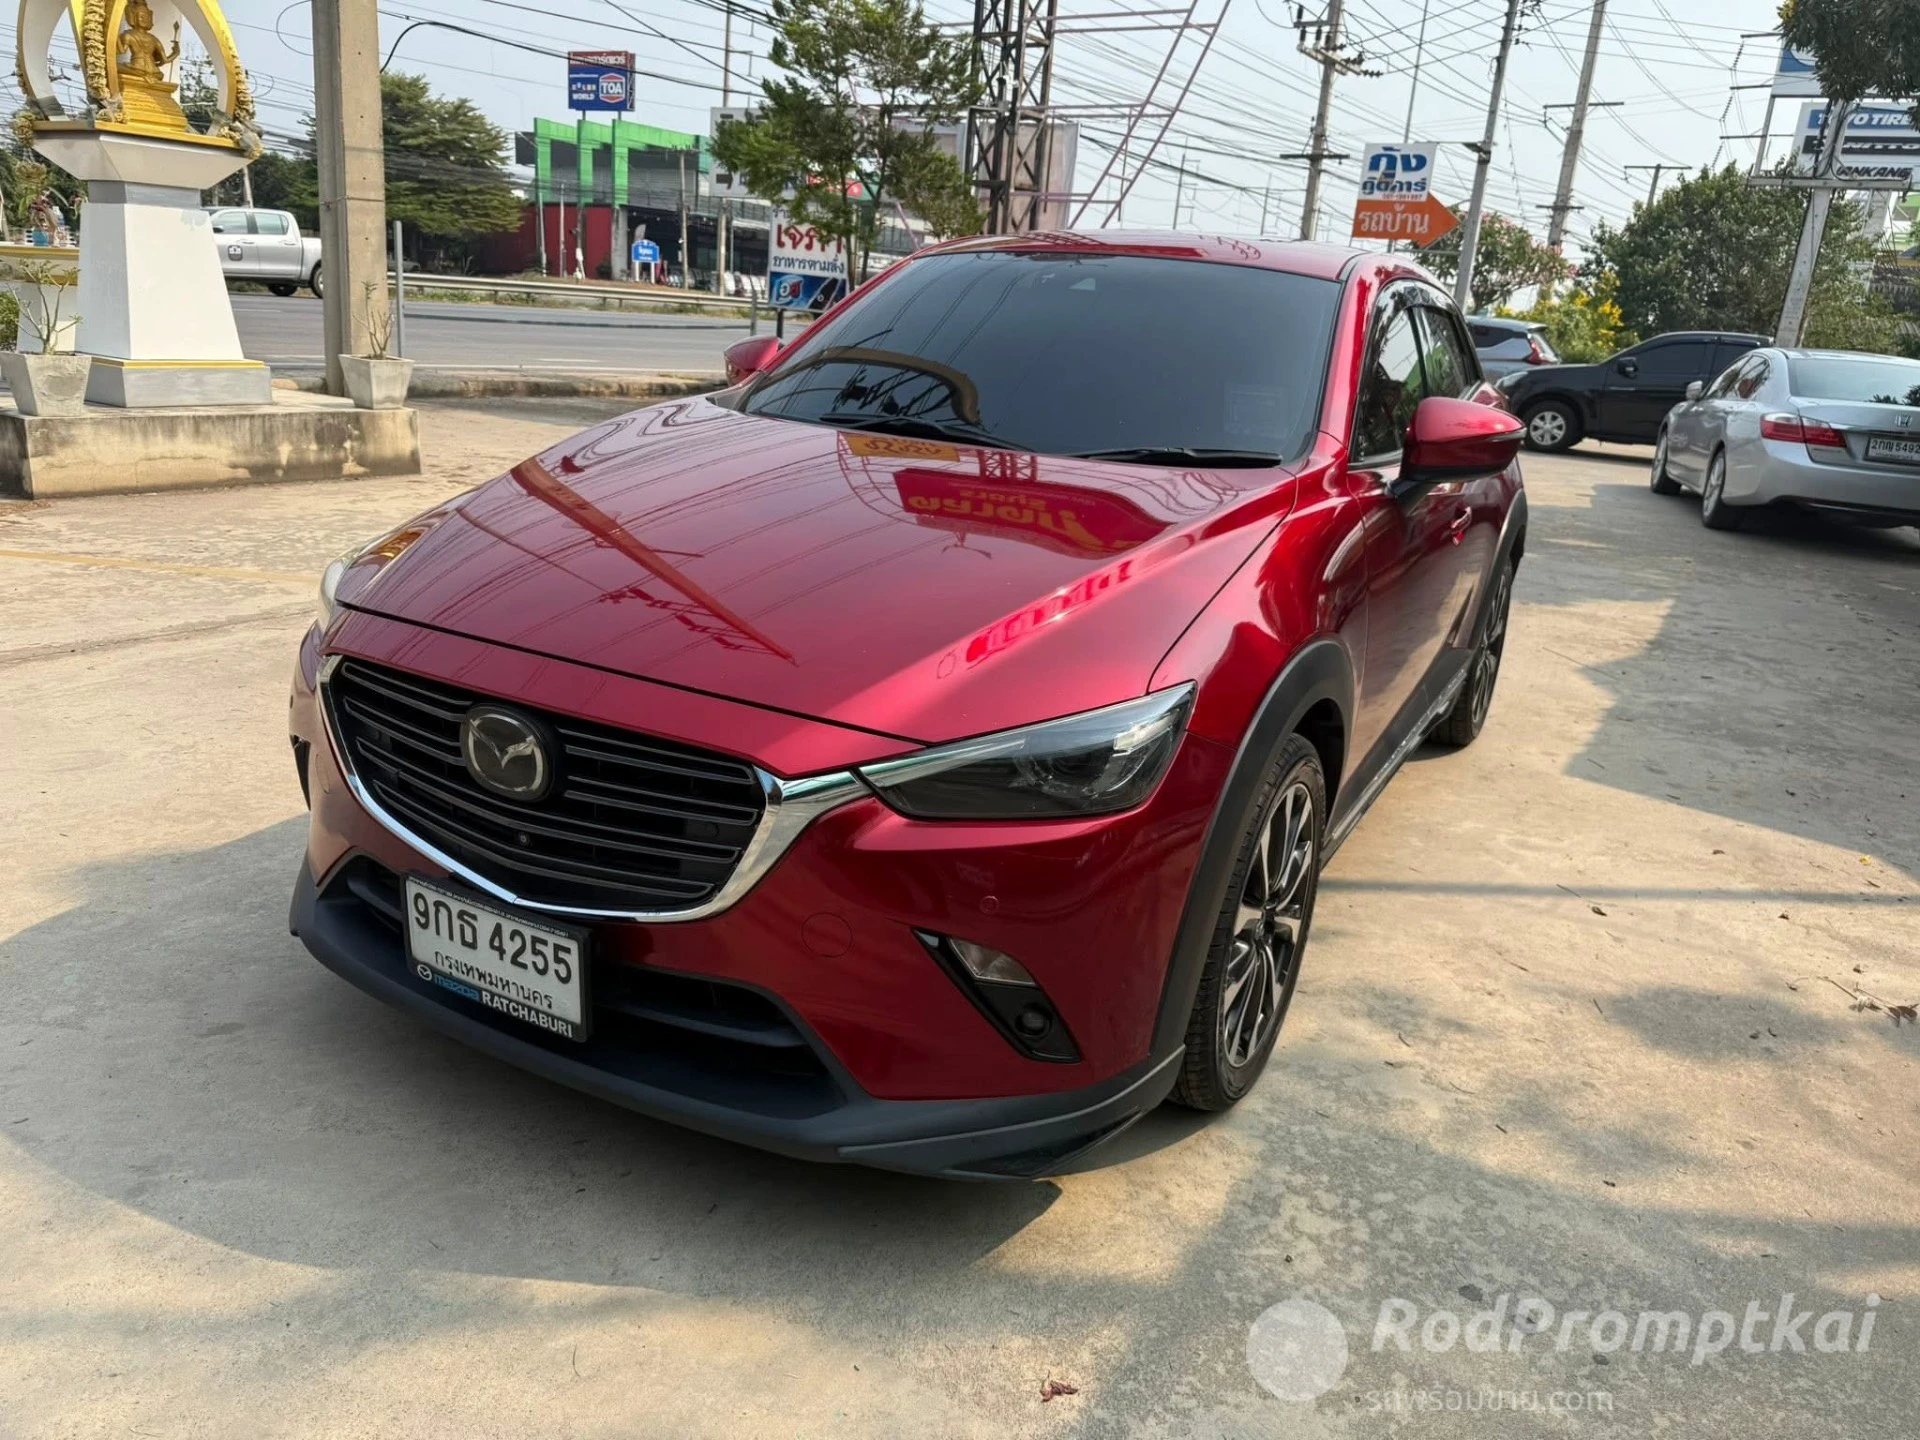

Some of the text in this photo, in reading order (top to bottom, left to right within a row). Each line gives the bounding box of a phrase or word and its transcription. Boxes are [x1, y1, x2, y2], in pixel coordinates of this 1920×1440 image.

[601, 82, 622, 94] TOA
[1367, 146, 1428, 179] กุ้ง
[1359, 203, 1430, 234] รถบ้าน
[773, 253, 846, 274] อาหารตามสั่ง
[413, 892, 479, 951] 9กธ
[489, 922, 573, 985] 4255
[434, 951, 553, 1010] กรุงเทพมหานคร
[433, 974, 573, 1038] mazda RATCHABURI
